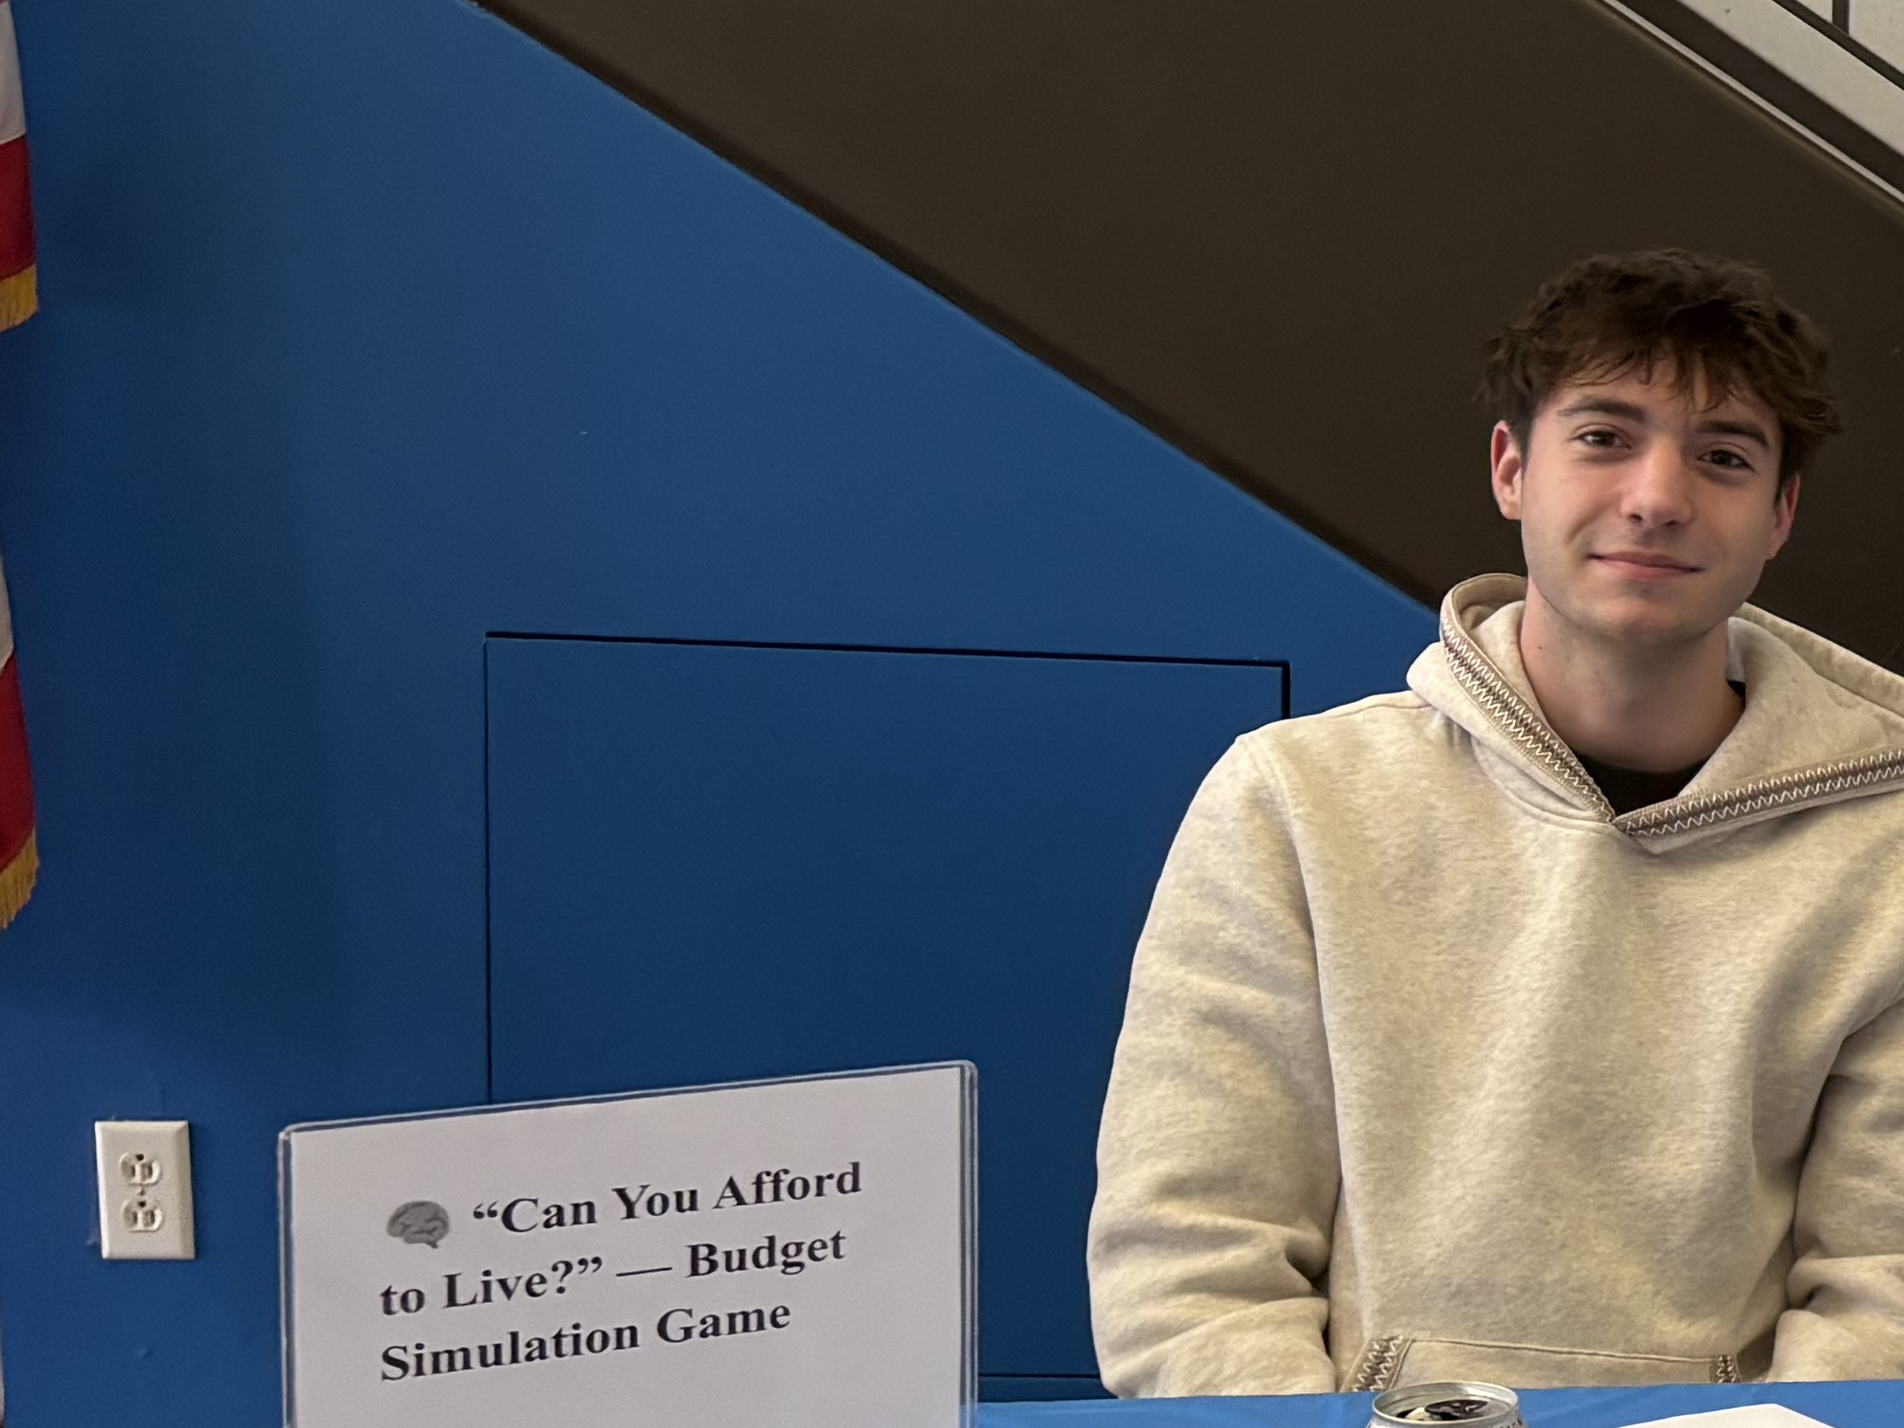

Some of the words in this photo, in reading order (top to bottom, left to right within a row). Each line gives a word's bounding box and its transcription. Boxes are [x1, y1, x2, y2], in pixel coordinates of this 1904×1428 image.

[611, 1181, 702, 1225] You
[711, 1160, 864, 1212] Afford
[378, 1280, 428, 1318] to
[686, 1227, 848, 1281] Budget
[378, 1322, 641, 1383] Simulation
[655, 1301, 792, 1345] Game
